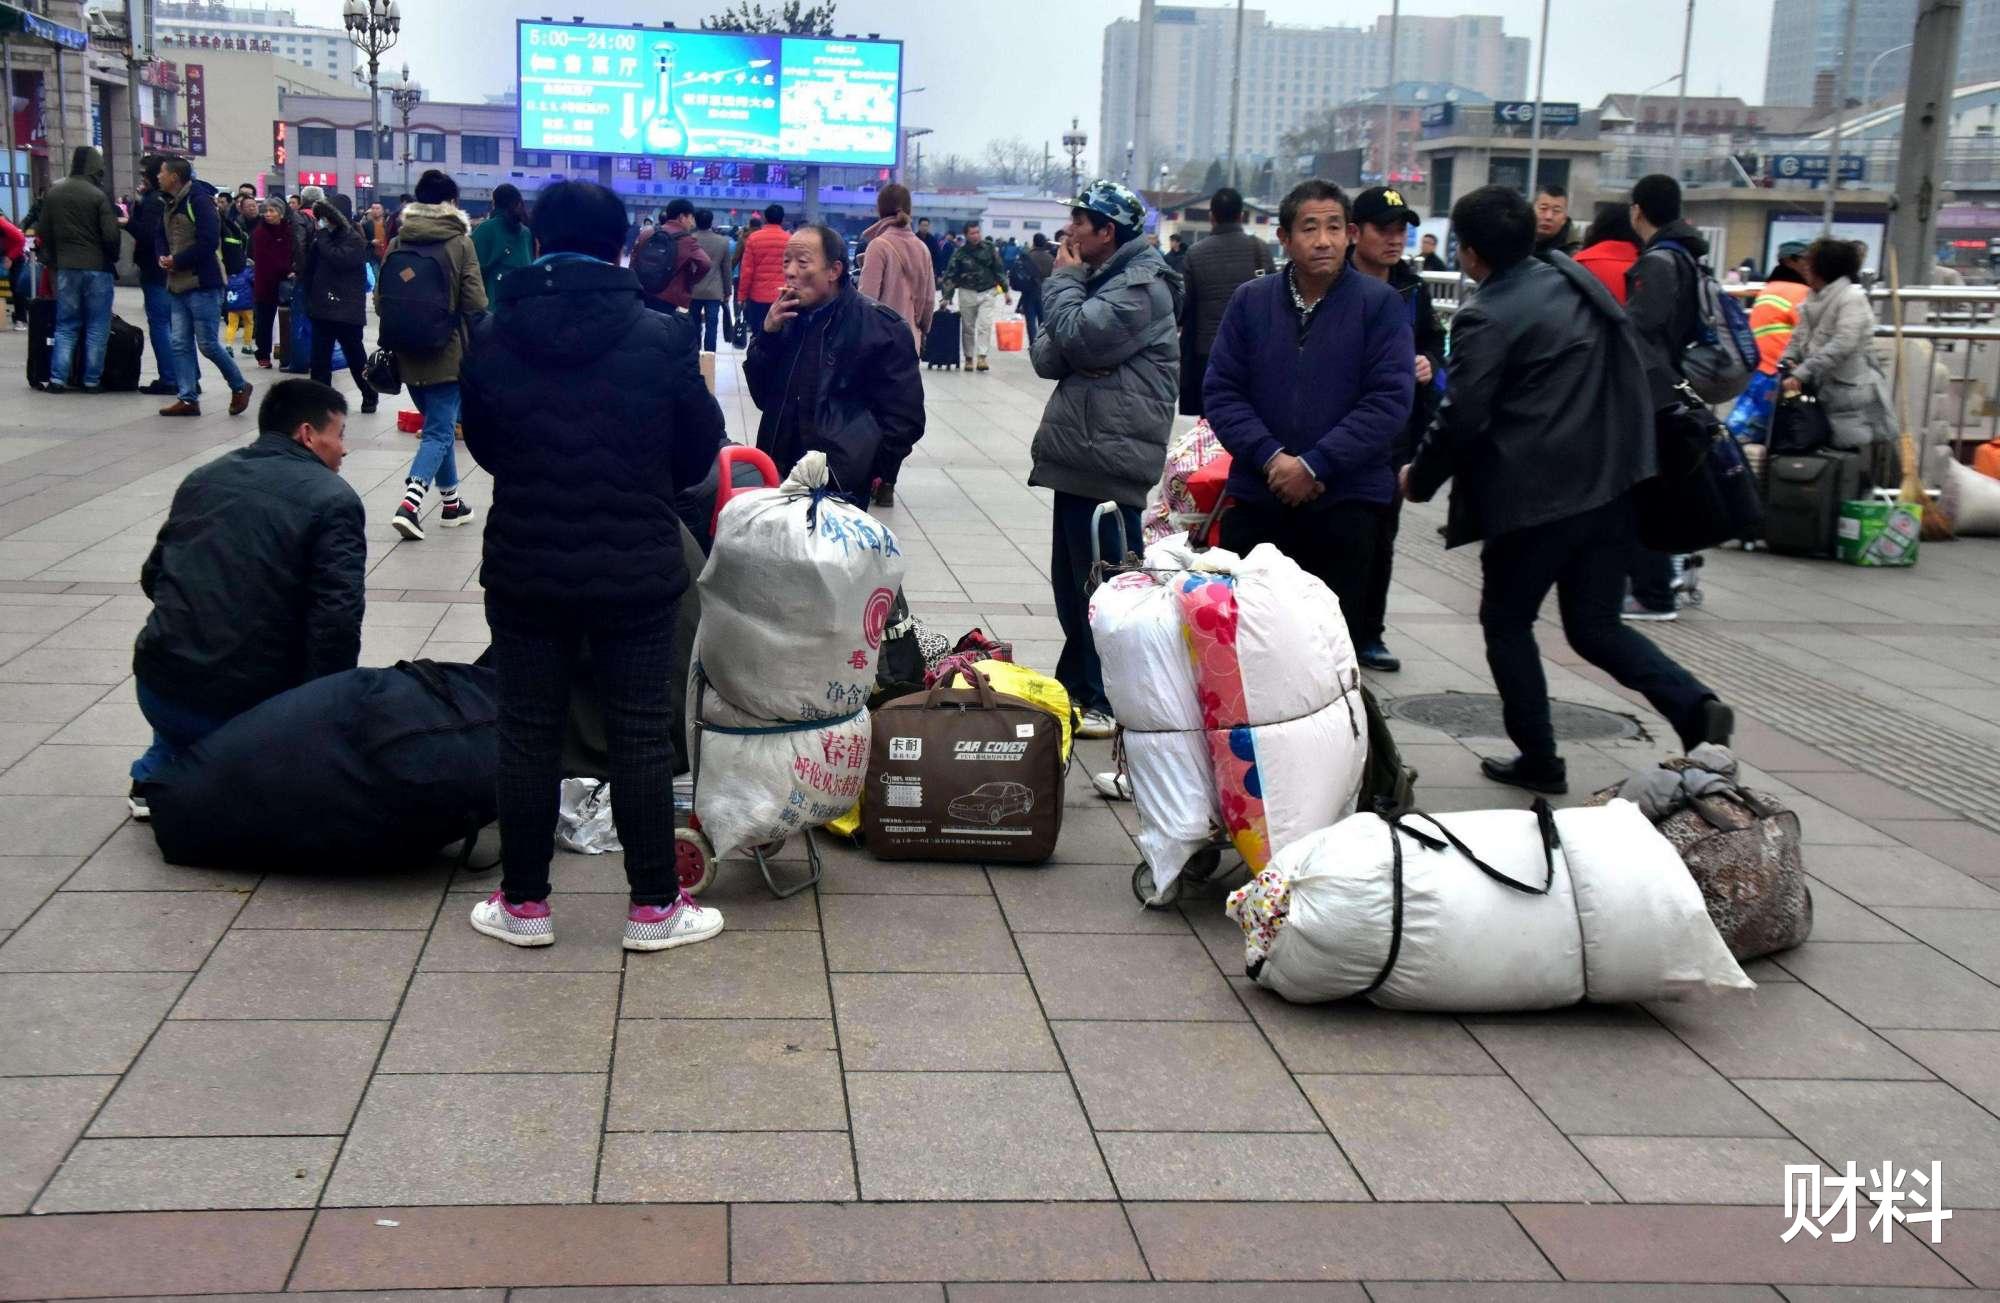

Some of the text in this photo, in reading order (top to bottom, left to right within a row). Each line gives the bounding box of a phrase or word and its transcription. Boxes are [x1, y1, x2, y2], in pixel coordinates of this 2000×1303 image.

[847, 648, 869, 669] 春
[892, 739, 918, 752] 卡耐
[954, 741, 1029, 753] CAR COVER
